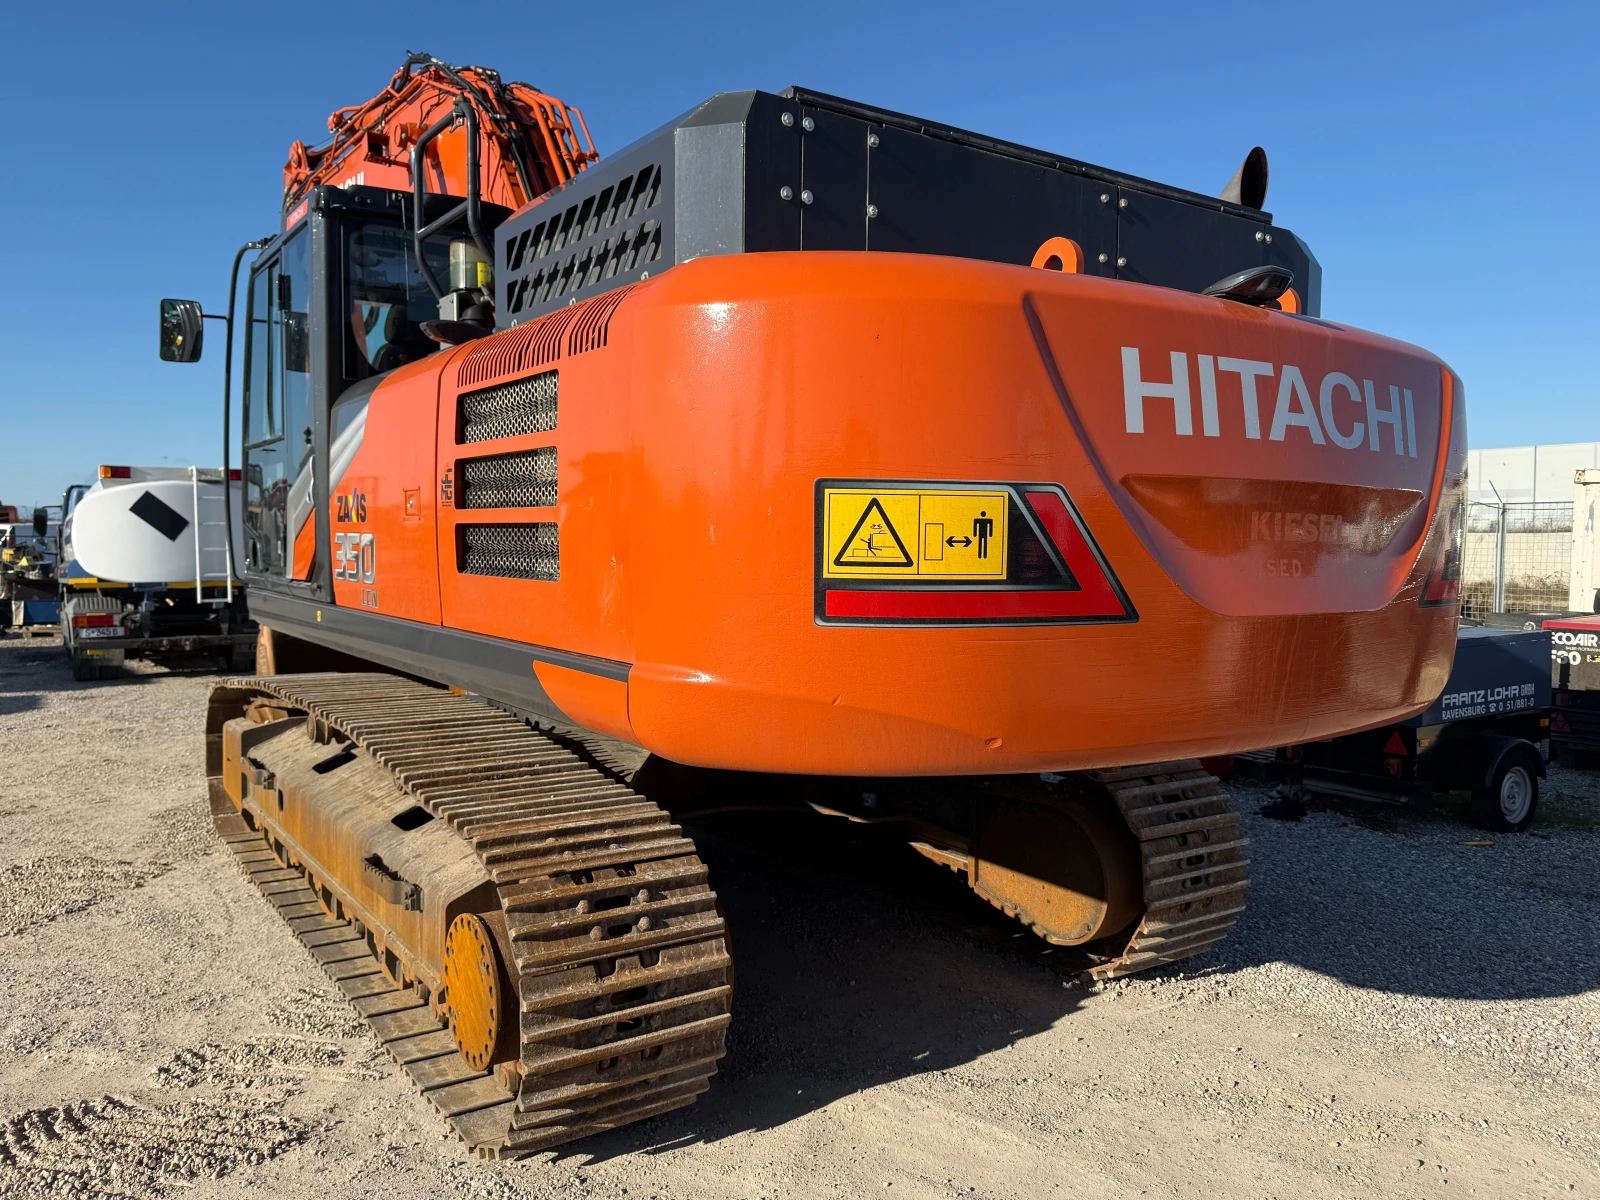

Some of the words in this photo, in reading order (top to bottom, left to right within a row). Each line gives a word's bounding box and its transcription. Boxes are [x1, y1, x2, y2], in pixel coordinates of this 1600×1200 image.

[1121, 346, 1418, 458] HITACHI
[337, 488, 367, 523] ZAXIS
[335, 533, 376, 584] 350
[361, 588, 378, 608] LCN
[1442, 689, 1485, 708] FRANZ
[1487, 685, 1519, 701] LOHR
[1442, 704, 1486, 720] RAVENSBURG
